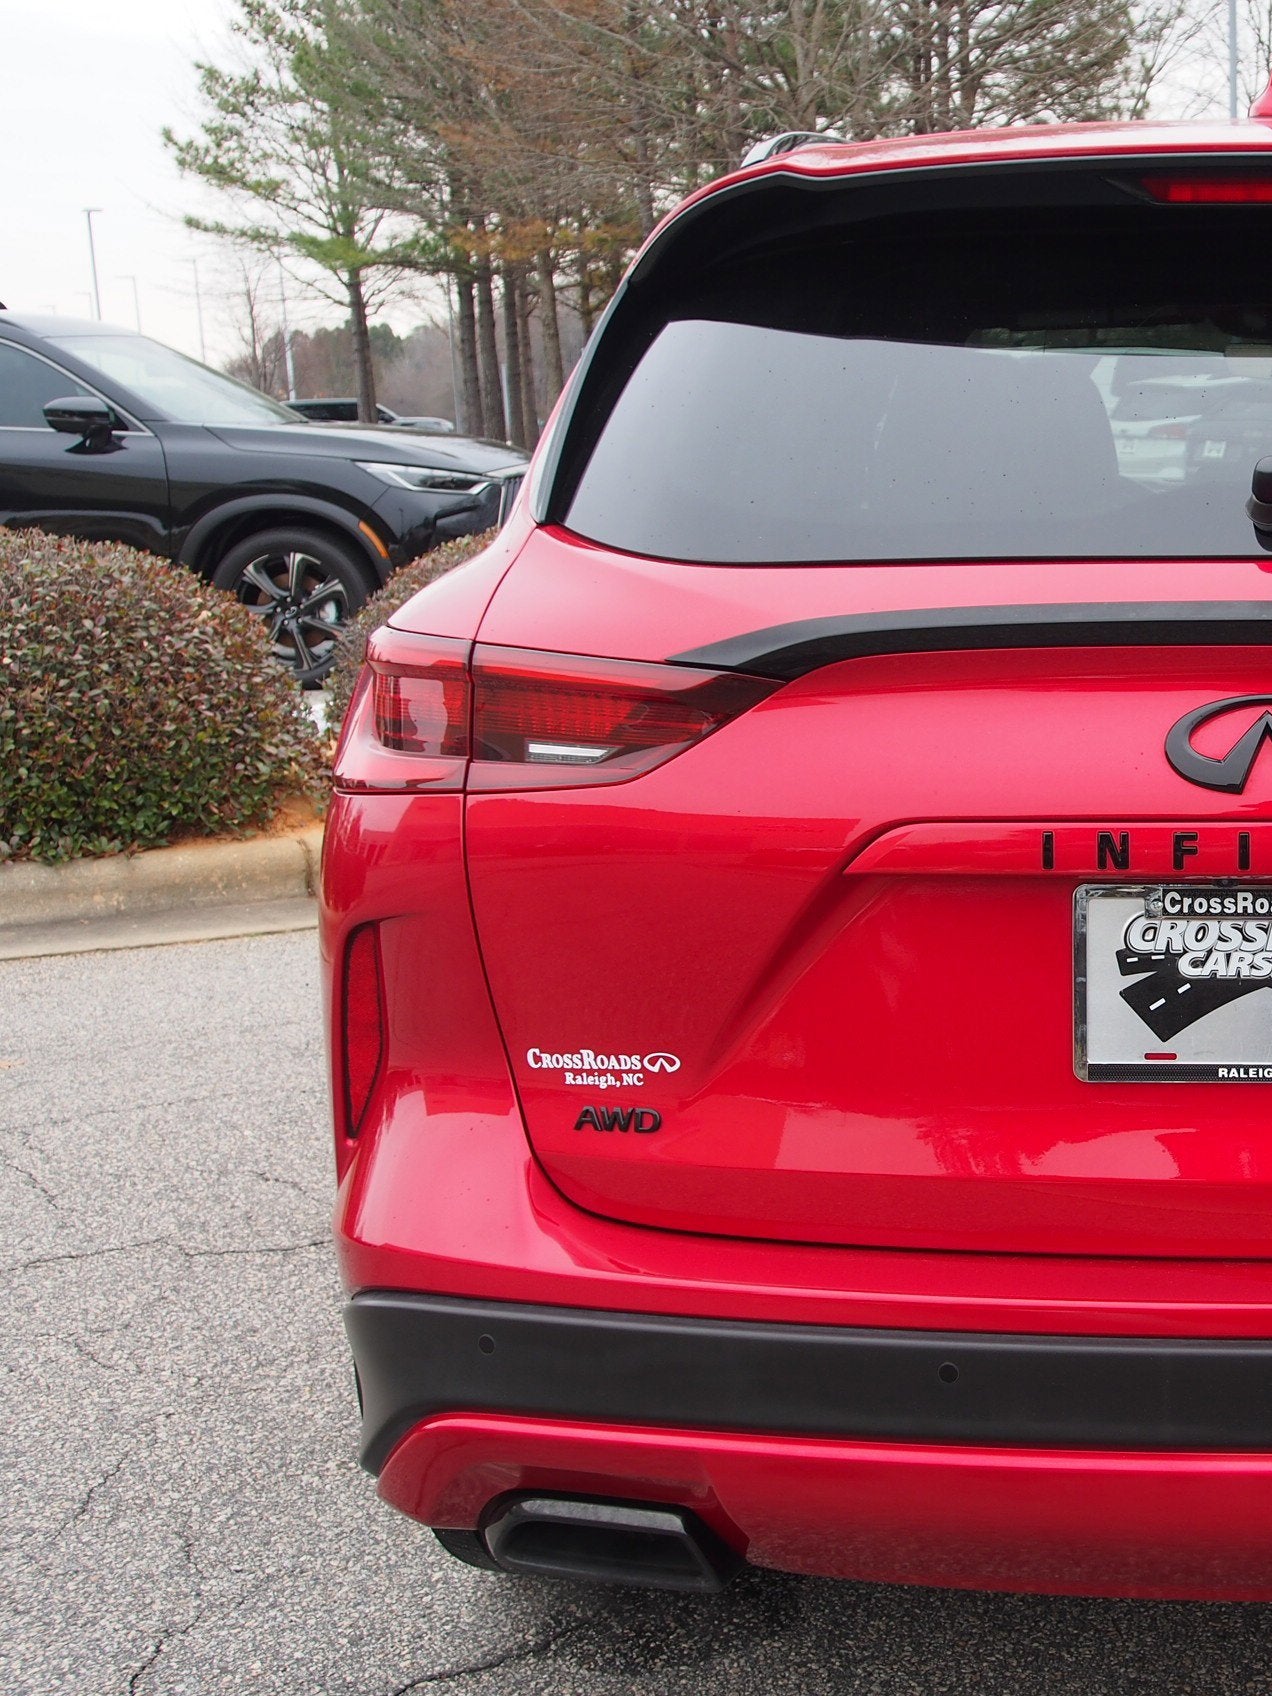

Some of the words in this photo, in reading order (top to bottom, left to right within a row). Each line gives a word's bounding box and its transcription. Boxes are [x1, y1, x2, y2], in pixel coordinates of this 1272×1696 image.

[565, 1072, 621, 1089] Raleigh,
[622, 1073, 644, 1086] NC
[574, 1105, 662, 1133] AWD
